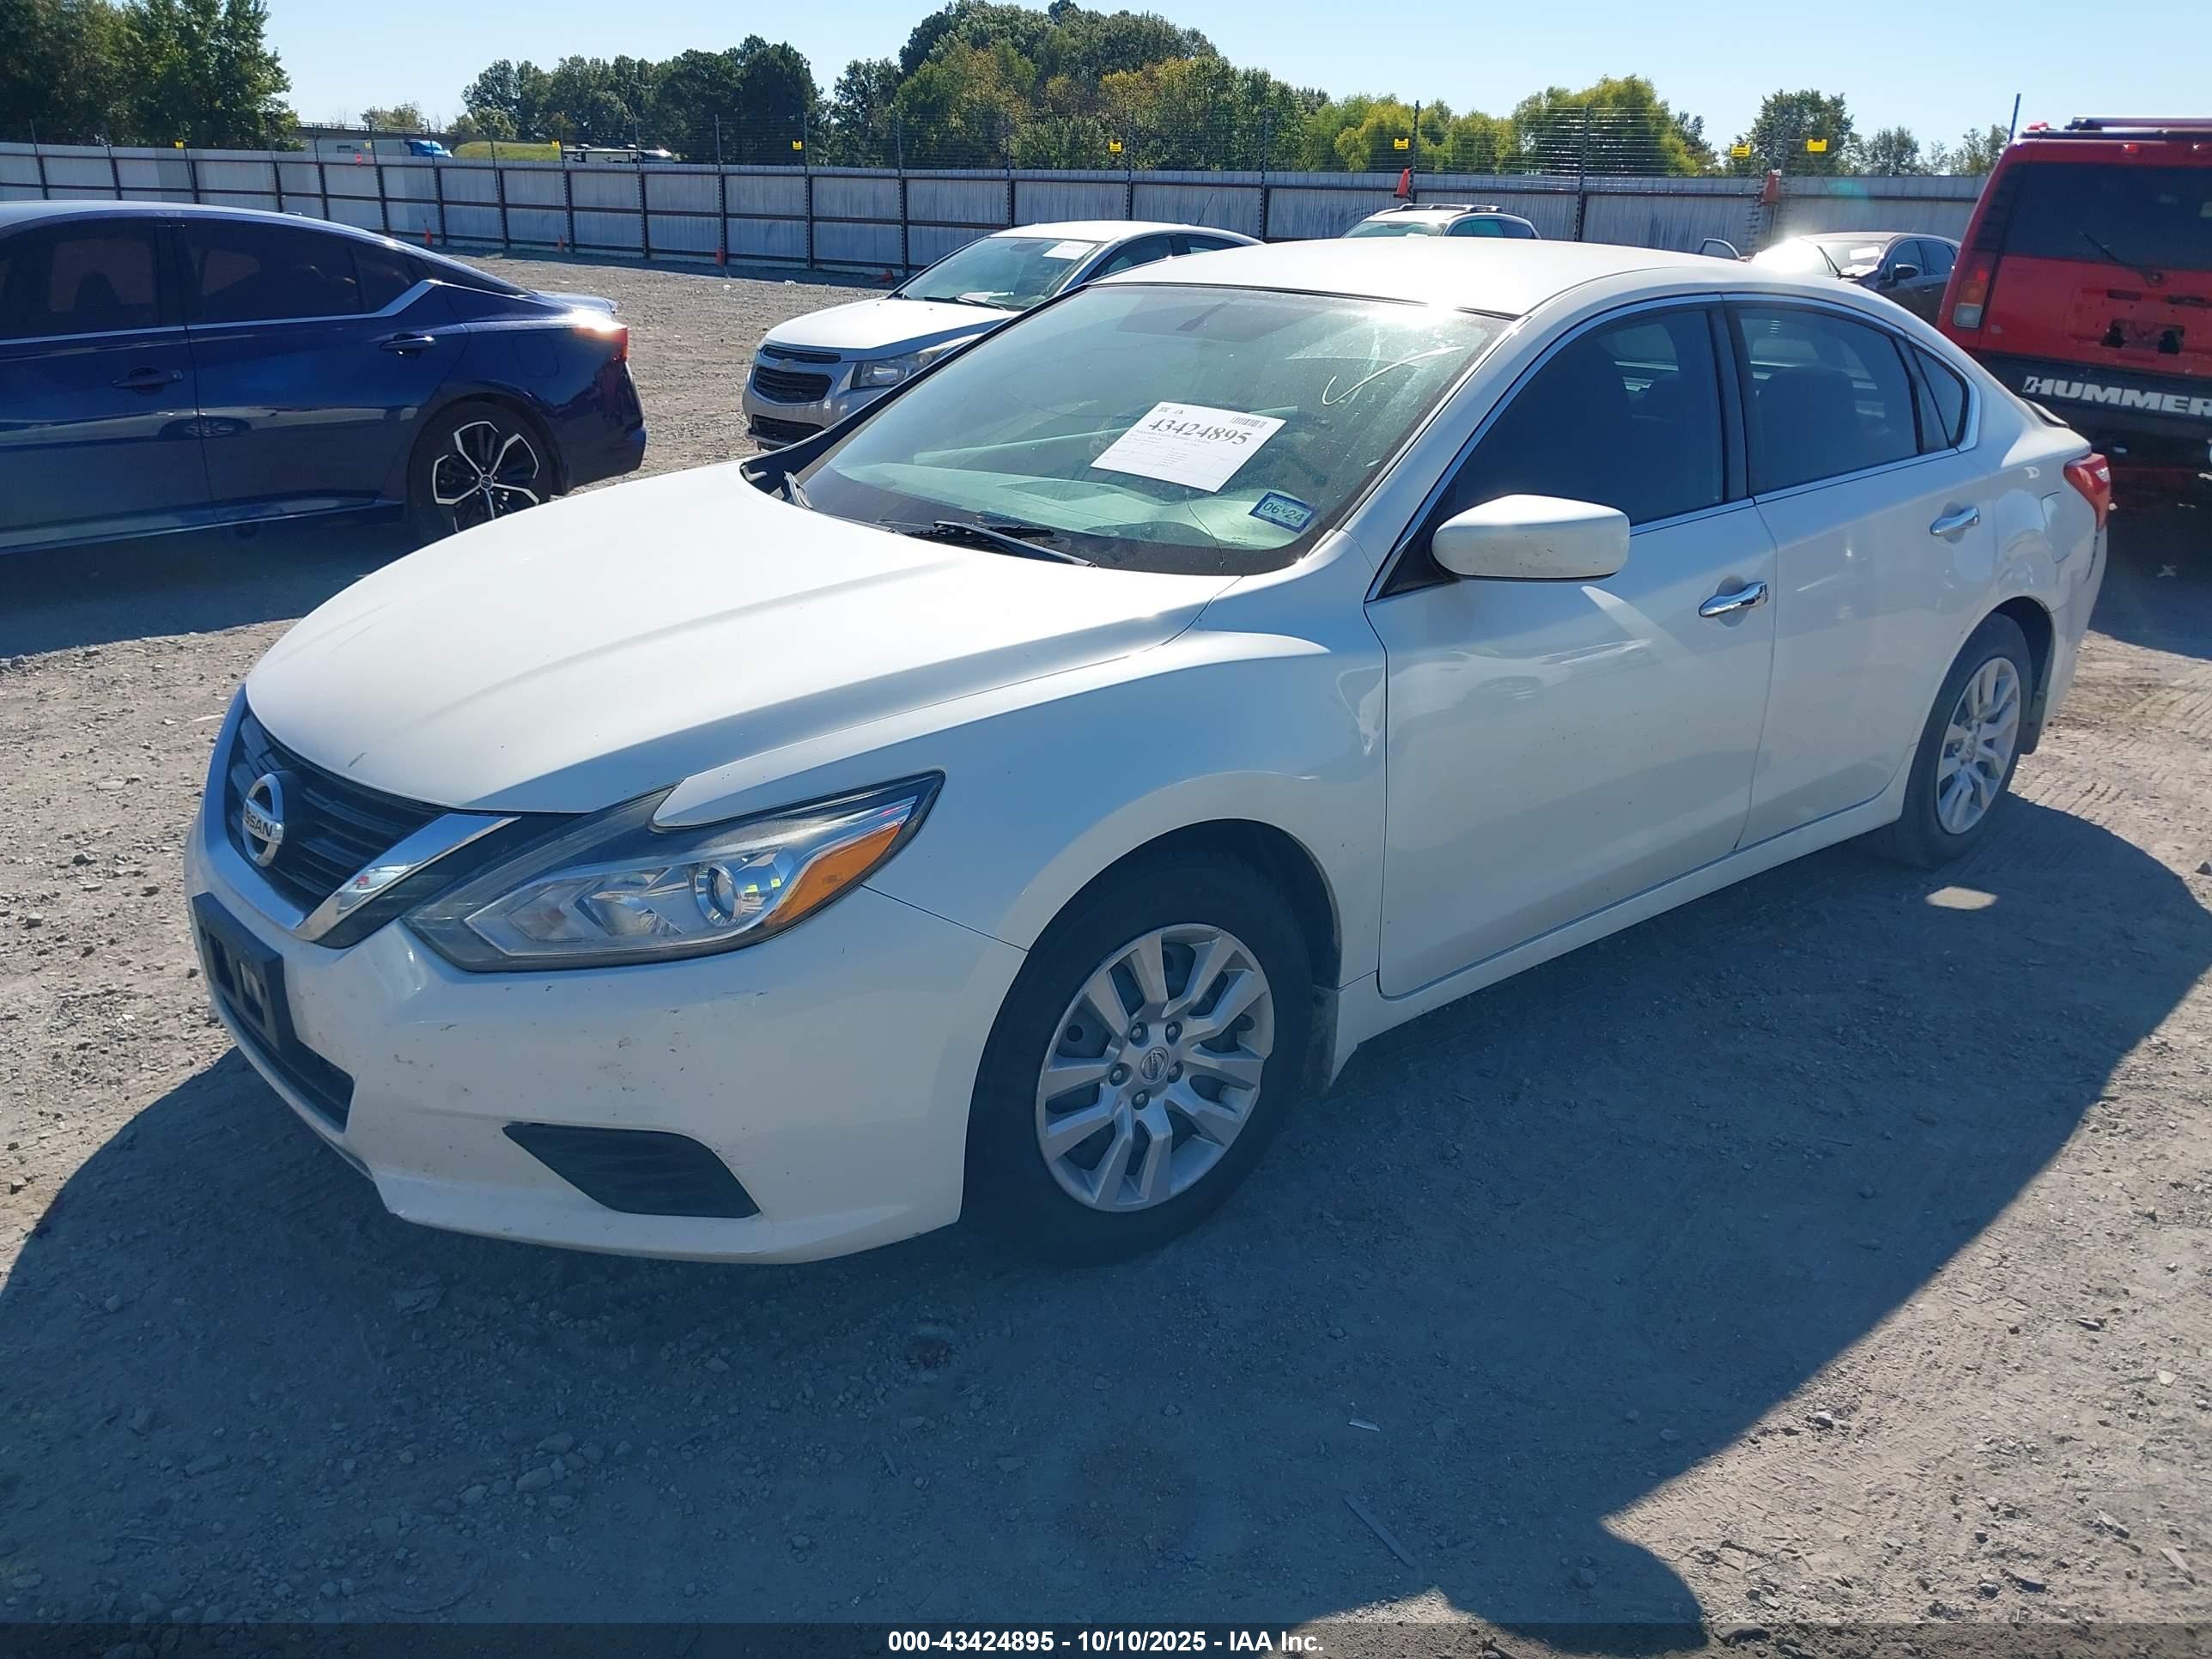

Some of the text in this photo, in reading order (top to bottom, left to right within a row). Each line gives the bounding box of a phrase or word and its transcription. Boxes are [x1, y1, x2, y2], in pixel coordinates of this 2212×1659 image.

[2022, 375, 2212, 416] HUMMER
[1148, 418, 1254, 446] 43424895
[1263, 501, 1305, 523] 06 24
[245, 809, 273, 837] SSAN
